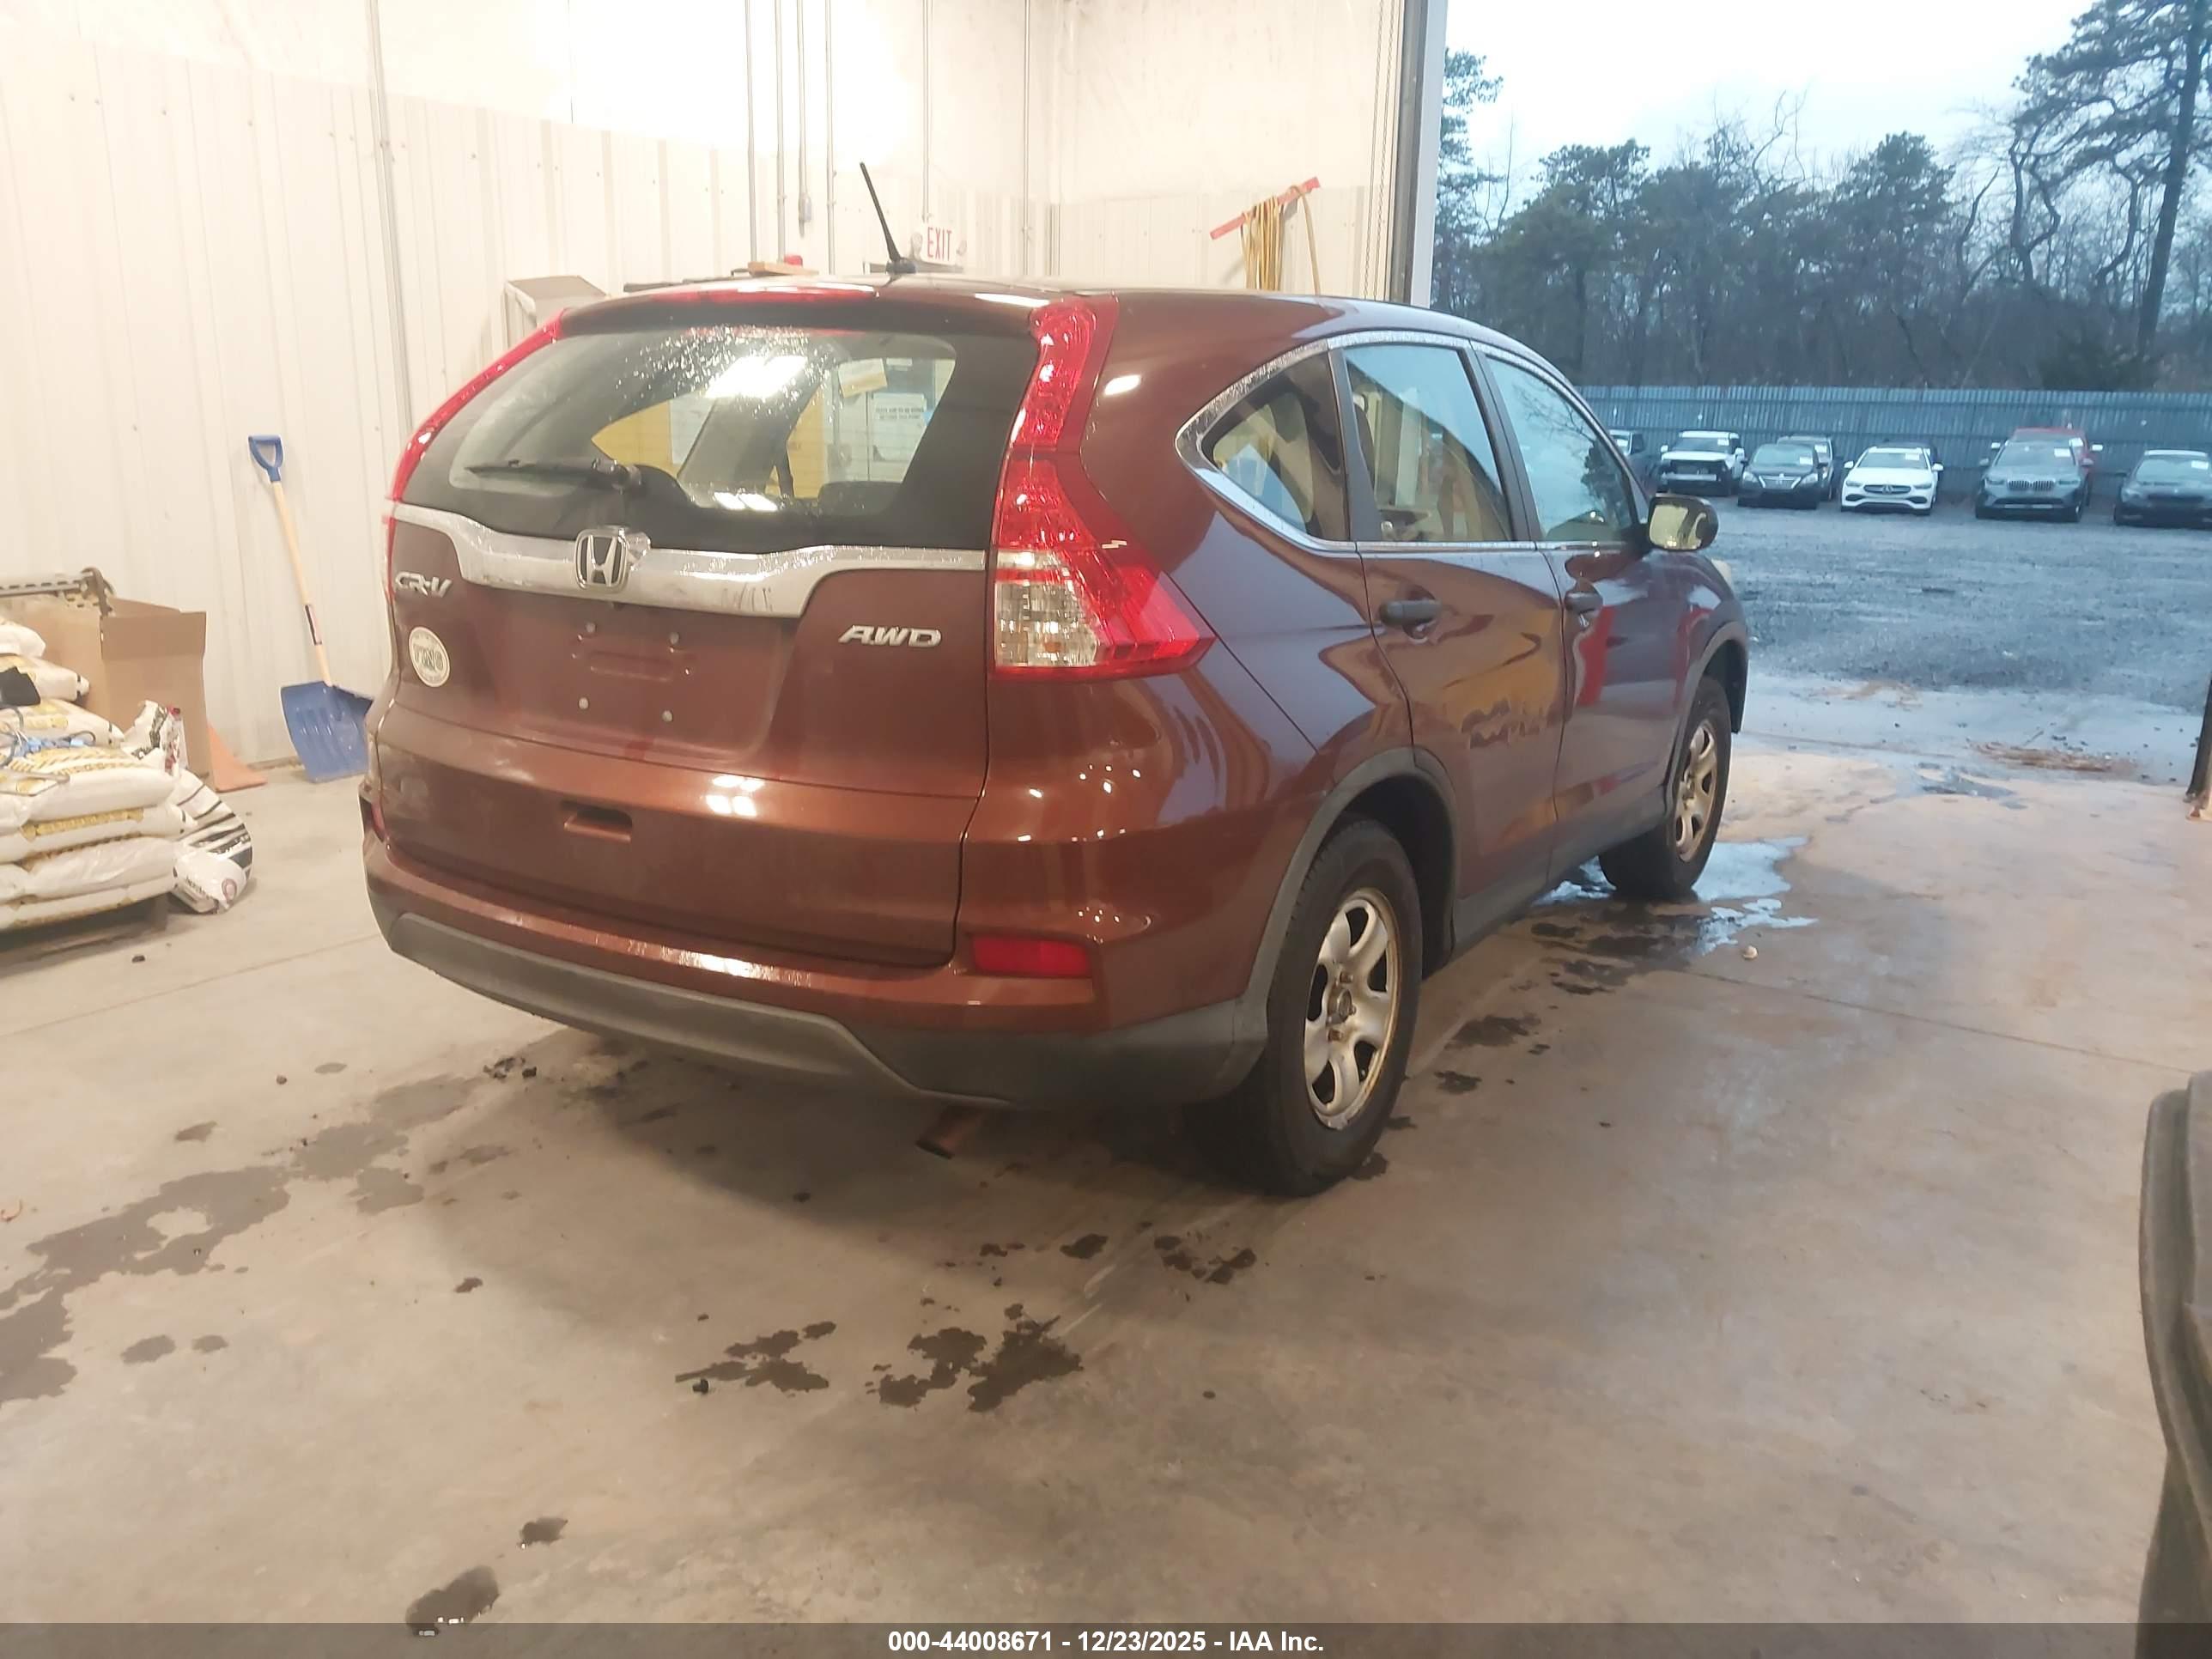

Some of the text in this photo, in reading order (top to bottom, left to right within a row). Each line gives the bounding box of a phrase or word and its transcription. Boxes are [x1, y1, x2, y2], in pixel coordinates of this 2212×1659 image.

[927, 227, 952, 261] EXIT
[395, 571, 453, 599] CR-V
[838, 625, 942, 647] AWD
